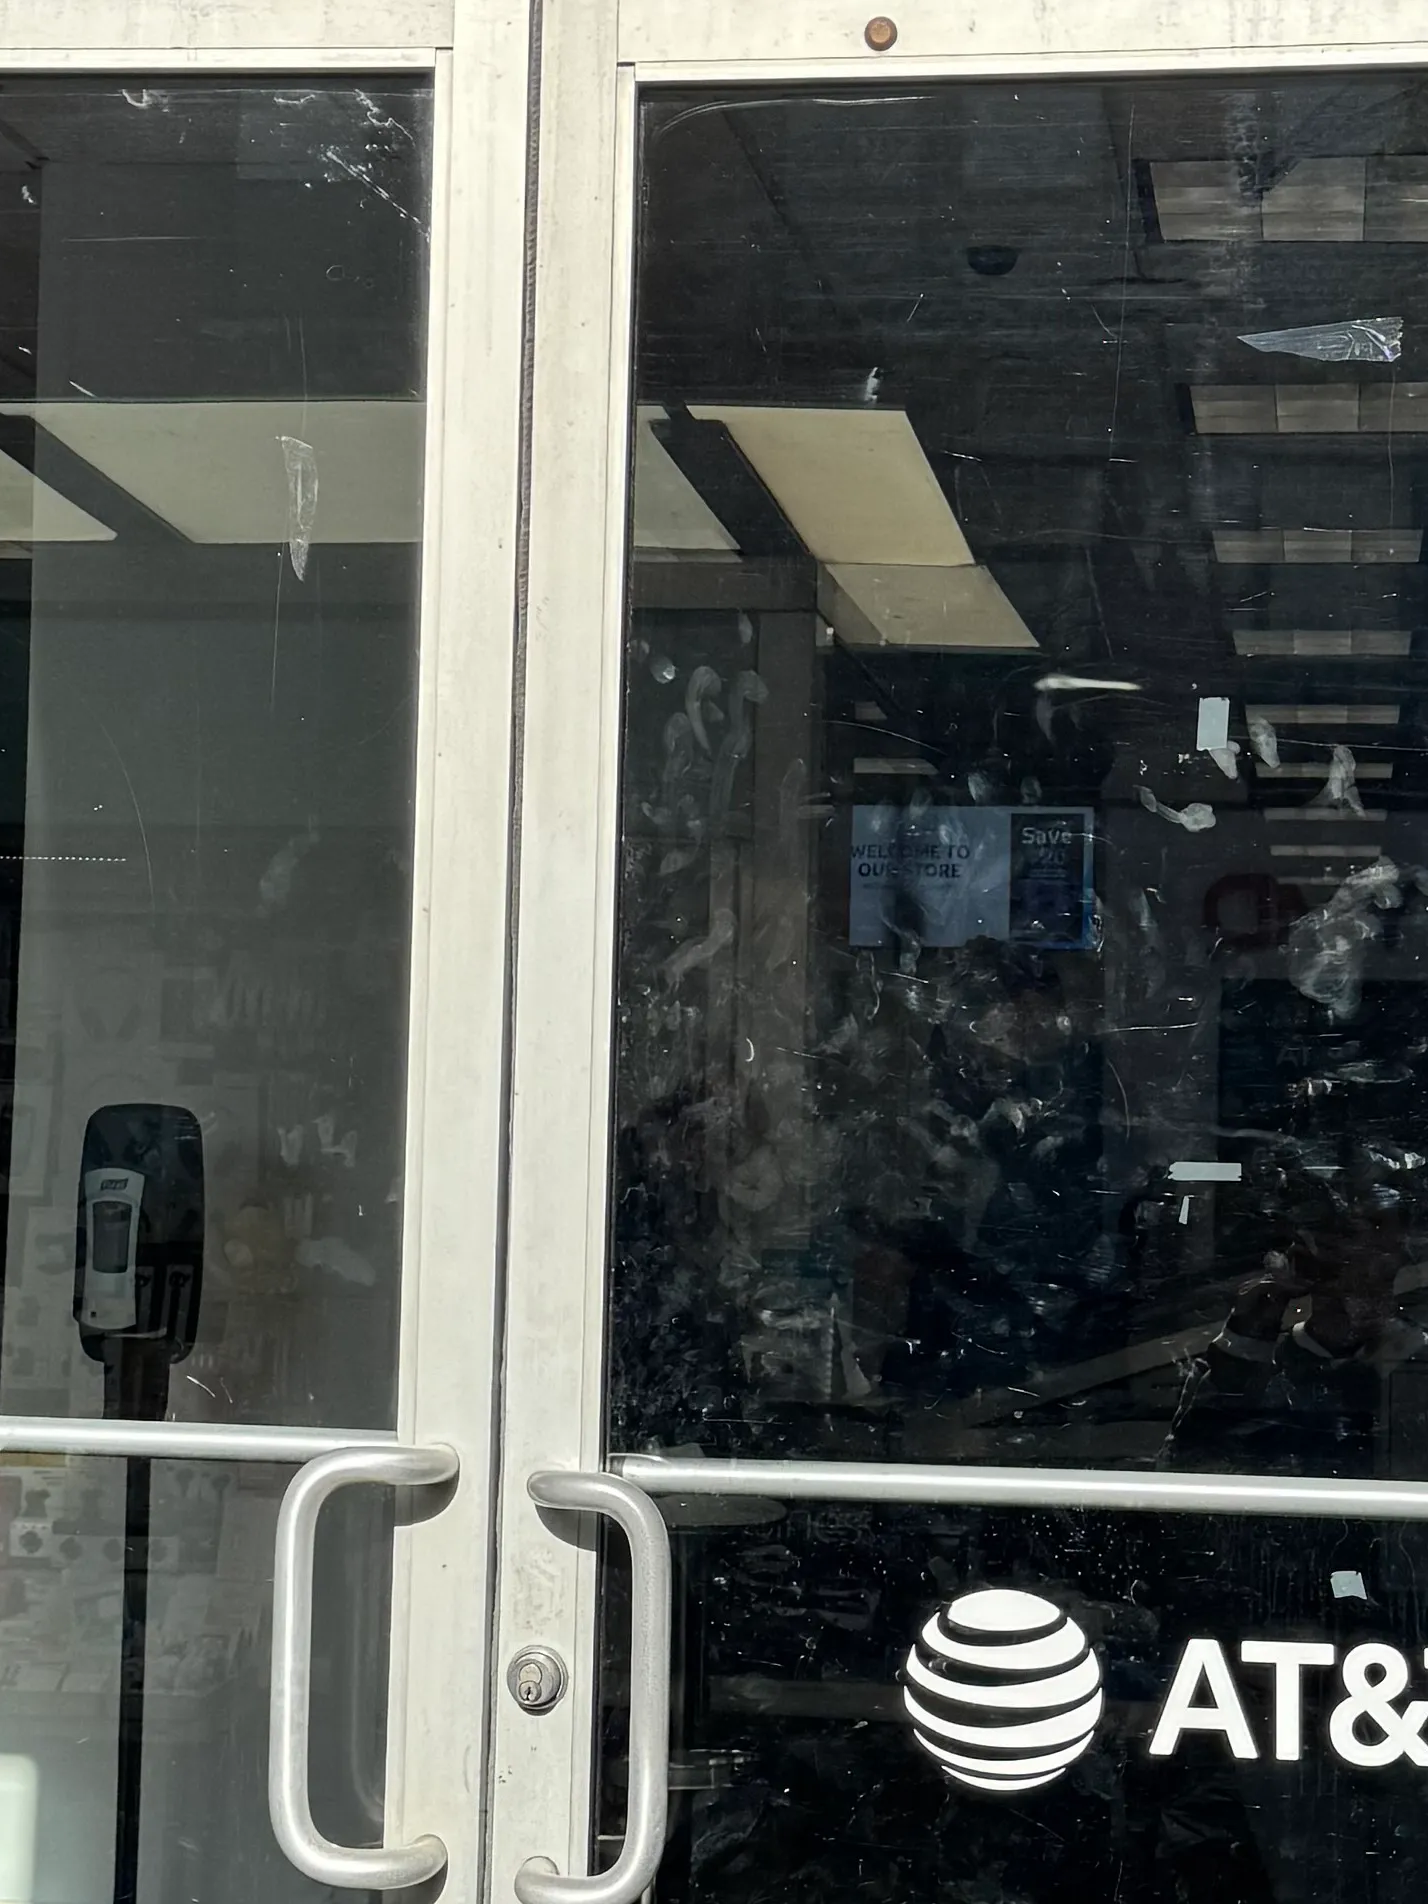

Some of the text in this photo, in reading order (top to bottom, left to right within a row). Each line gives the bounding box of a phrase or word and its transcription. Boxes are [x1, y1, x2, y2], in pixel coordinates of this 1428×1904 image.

[1021, 827, 1072, 845] Save
[851, 843, 970, 860] WELCOME TO
[858, 862, 961, 878] OUR STORE
